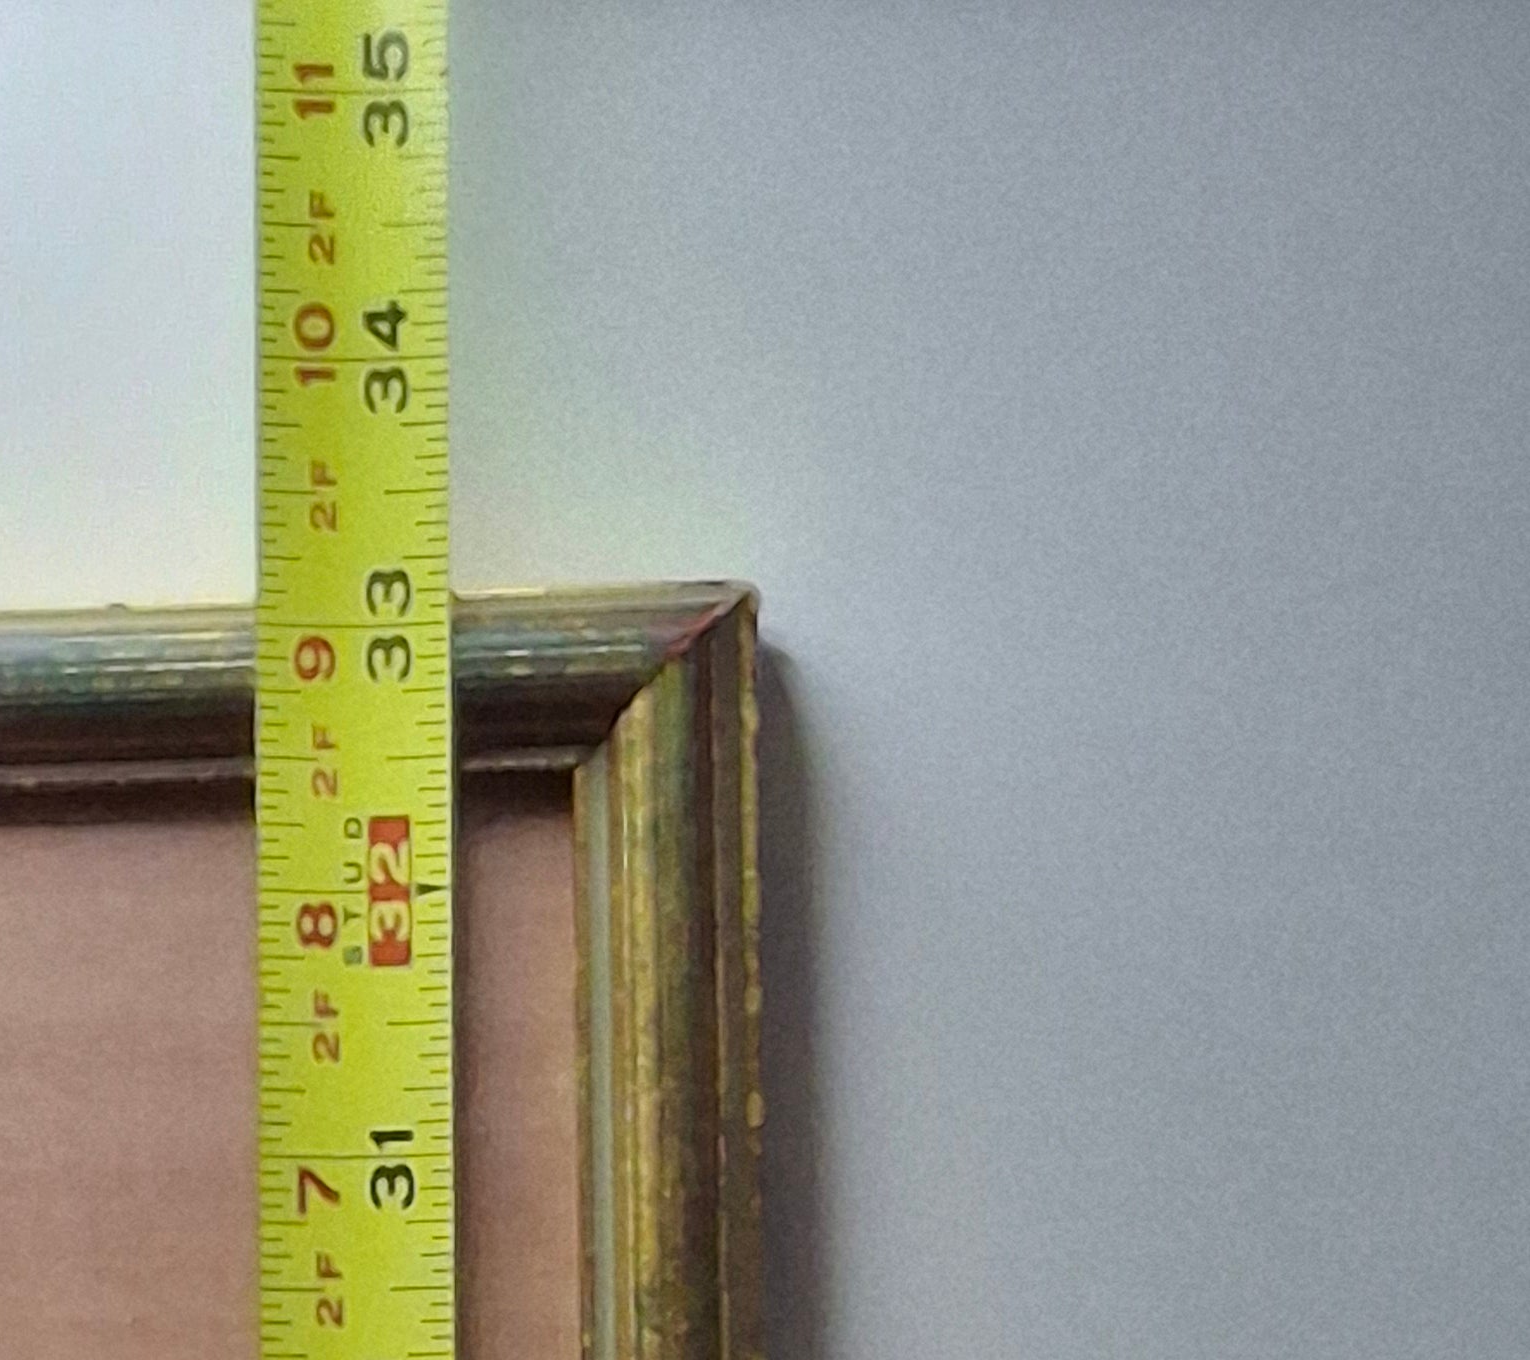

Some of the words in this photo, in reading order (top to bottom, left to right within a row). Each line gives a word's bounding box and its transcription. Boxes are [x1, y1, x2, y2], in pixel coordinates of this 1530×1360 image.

[293, 61, 335, 121] 11
[361, 31, 409, 148] 35
[293, 302, 336, 387] 10
[361, 300, 408, 415] 34
[294, 635, 336, 683] 9
[365, 568, 412, 683] 33
[296, 902, 338, 950] 8
[343, 816, 362, 966] STUD
[369, 839, 408, 943] 32
[297, 1167, 339, 1216] 7
[369, 1128, 414, 1210] 31
